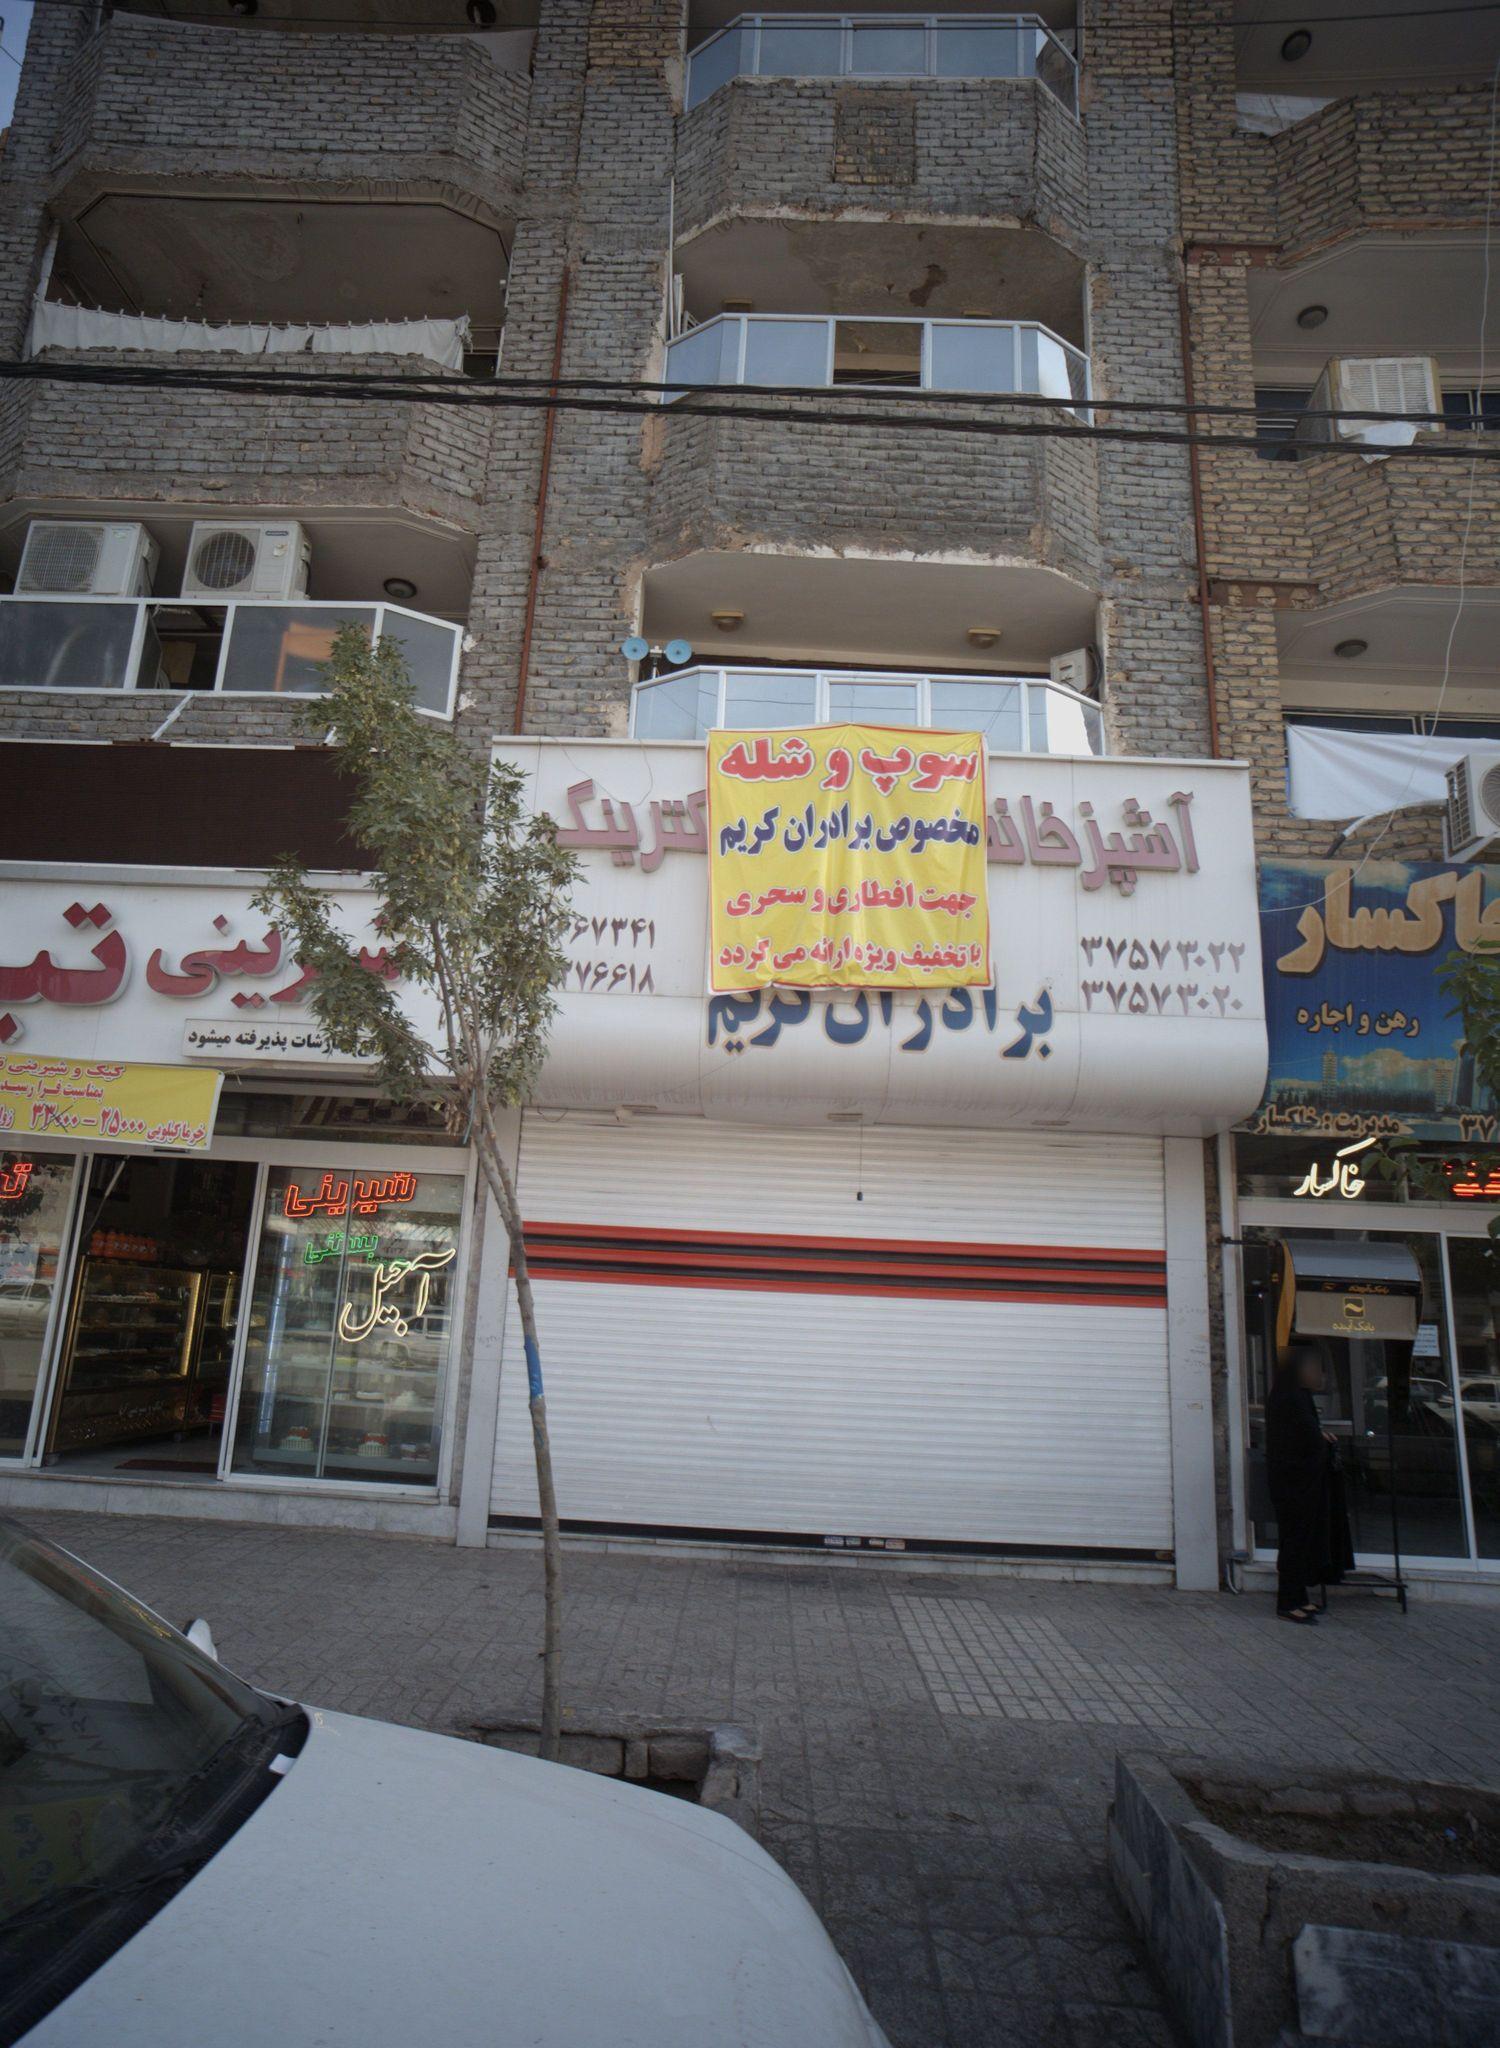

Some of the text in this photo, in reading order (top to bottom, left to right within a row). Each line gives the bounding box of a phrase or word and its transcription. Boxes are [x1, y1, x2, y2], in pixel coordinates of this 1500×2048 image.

[720, 737, 979, 794] سوپ و شله
[720, 801, 980, 856] مخصوص برادران کریم
[726, 879, 977, 919] جهت افطاری و سحری
[773, 946, 806, 970] می
[810, 936, 851, 970] ارائه
[855, 942, 896, 972] ویژه
[900, 943, 968, 973] تخفیف
[970, 943, 982, 968] با
[1080, 936, 1246, 973] ۳۷۵۷۳۰۲۲
[1080, 980, 1244, 1017] ۳۷۵۷۳۰۲۰
[1297, 1002, 1420, 1037] رهن و اجاره
[188, 1029, 231, 1048] میشود
[235, 1030, 287, 1052] پذیرفته
[8, 1061, 68, 1078] شیرینی
[73, 1068, 81, 1079] و
[87, 1064, 124, 1079] کیک
[100, 1107, 146, 1135] ۲۵۰۰۰
[180, 1122, 207, 1146] خرما
[1293, 1138, 1376, 1198] خاکسار
[285, 1172, 417, 1217] شیرینی
[304, 1234, 378, 1263] بستنی
[339, 1248, 456, 1342] آجیل
